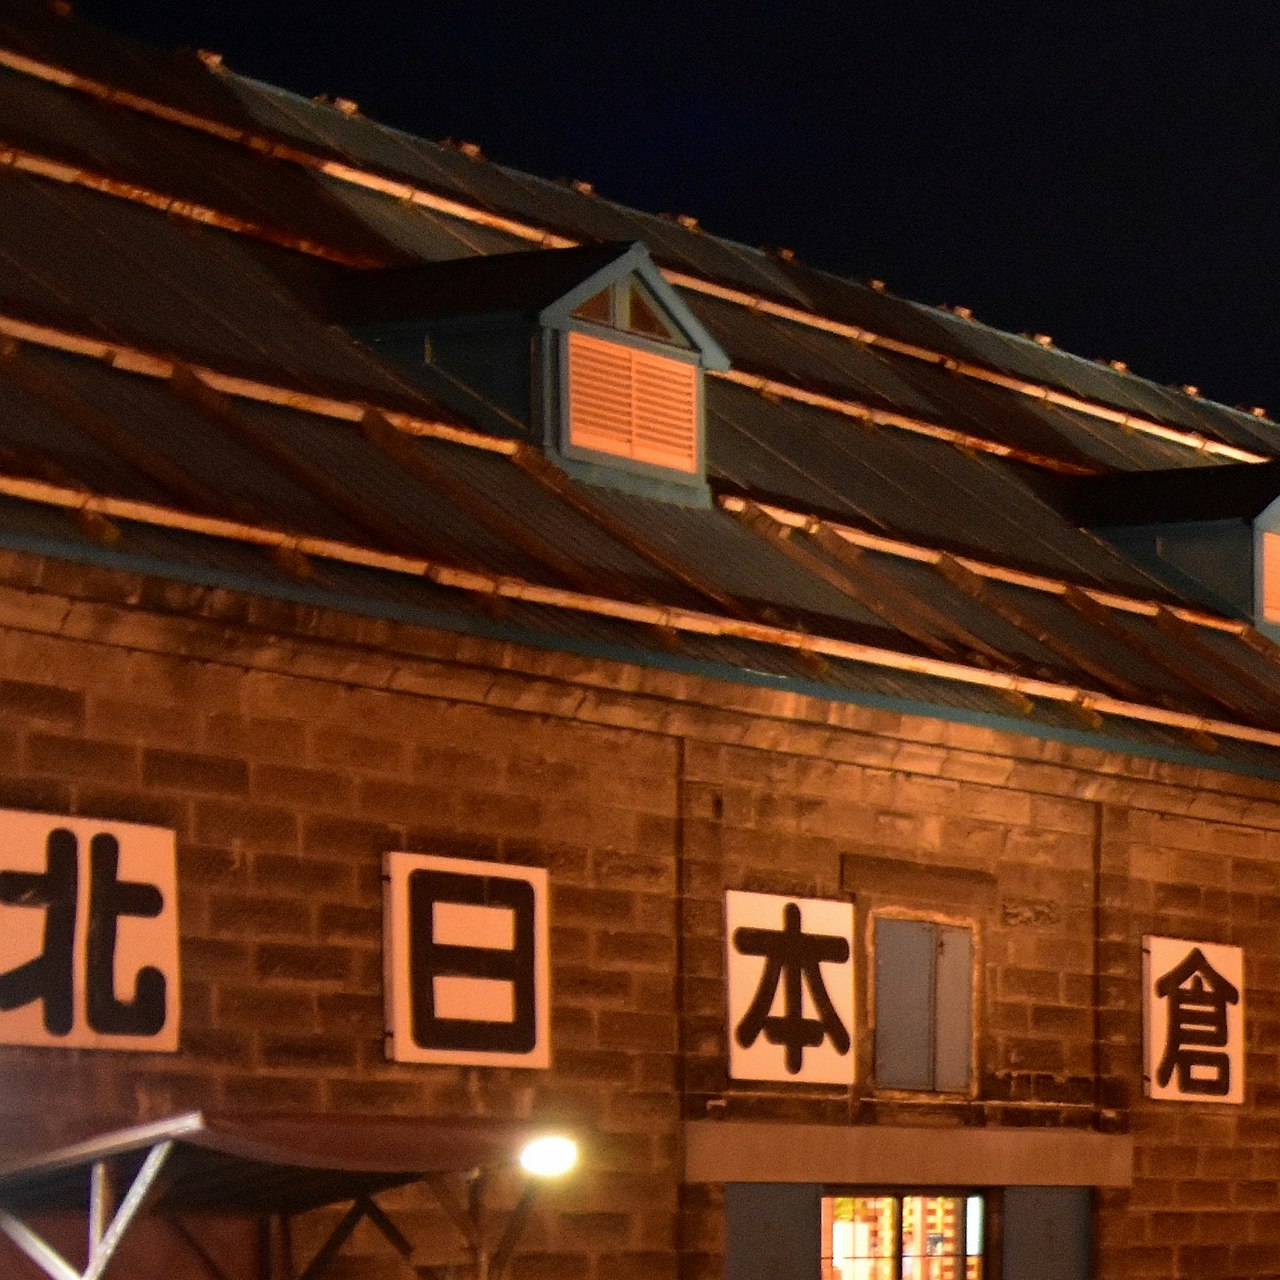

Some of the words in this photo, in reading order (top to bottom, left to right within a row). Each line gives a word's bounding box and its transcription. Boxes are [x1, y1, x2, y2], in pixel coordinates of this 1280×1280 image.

[0, 828, 166, 1037] 北
[409, 868, 536, 1054] 日
[733, 902, 850, 1074] 本
[1156, 946, 1240, 1096] 倉
